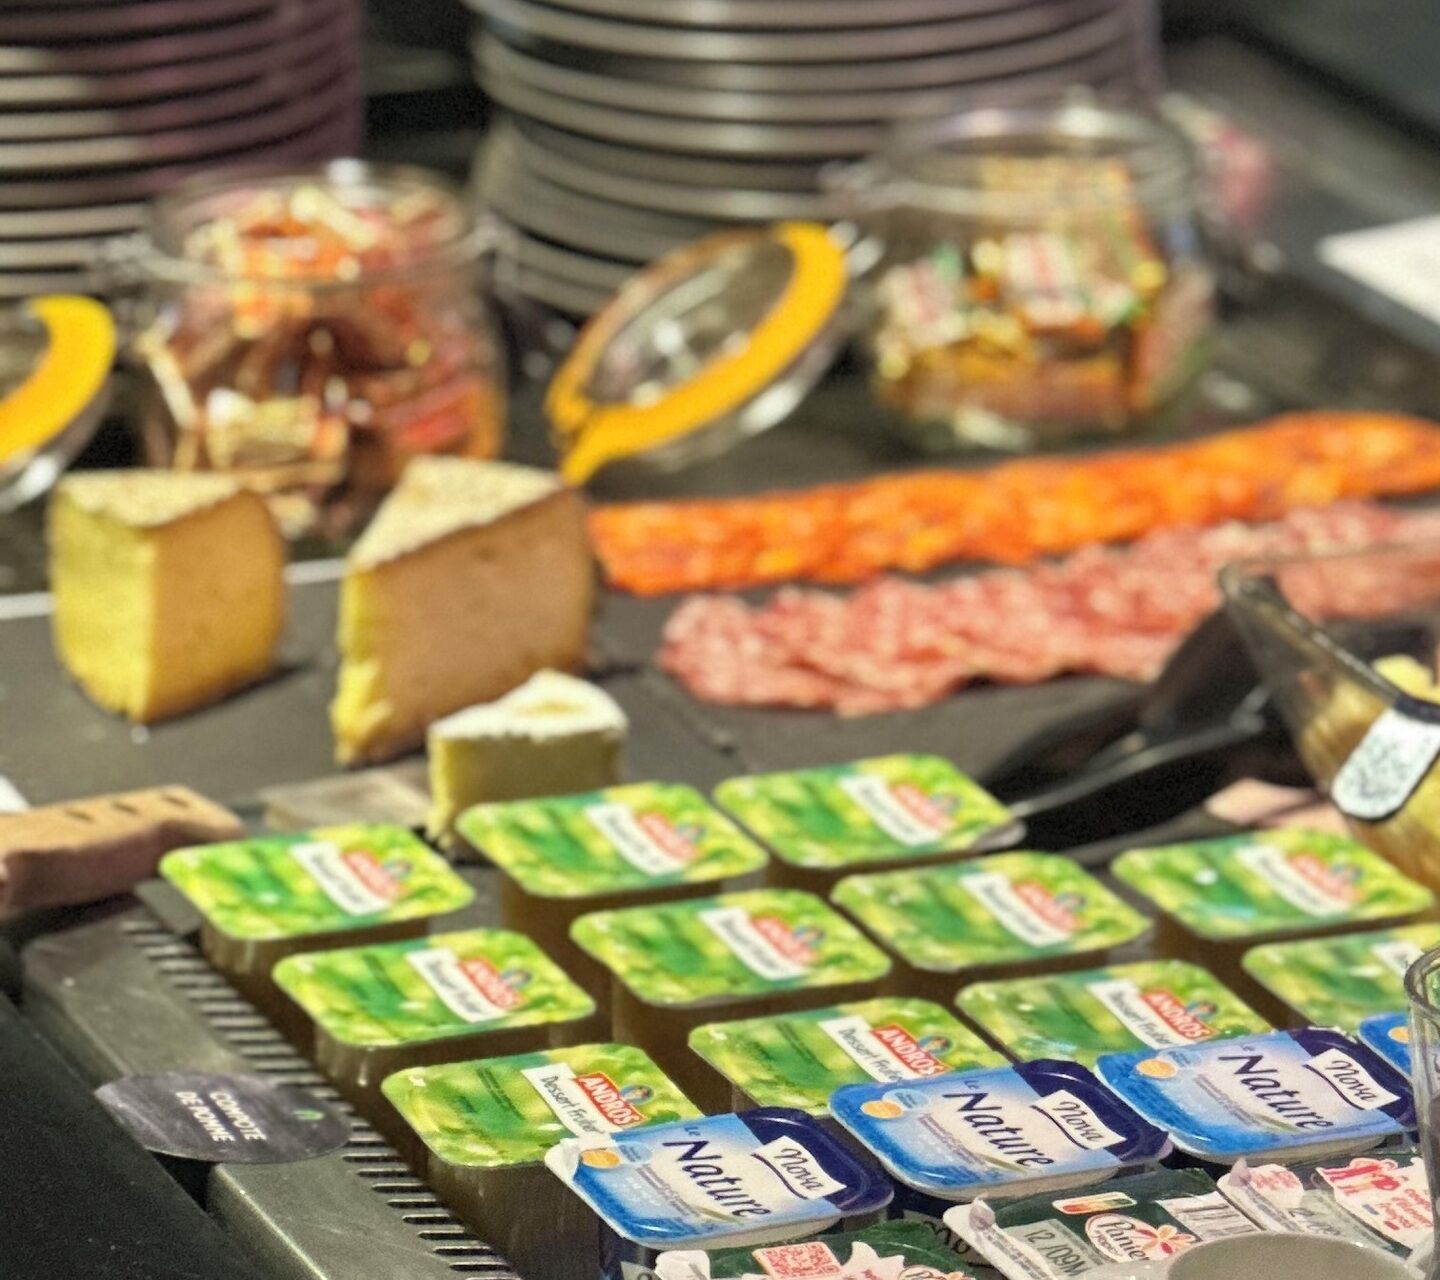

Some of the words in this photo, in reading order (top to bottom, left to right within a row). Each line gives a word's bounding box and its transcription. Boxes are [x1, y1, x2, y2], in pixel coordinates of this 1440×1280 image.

[1147, 991, 1211, 1038] ANDROS
[874, 1028, 946, 1076] ANDROS
[175, 1091, 204, 1106] DE
[540, 1075, 581, 1108] Dessert
[578, 1076, 640, 1126] ANDROS
[1217, 1053, 1334, 1129] Nature
[1326, 1059, 1378, 1102] Nova
[188, 1106, 236, 1142] POMME
[209, 1090, 268, 1141] COMPOTE
[942, 1091, 1055, 1167] Nature
[1050, 1100, 1104, 1143] Nova
[661, 1139, 772, 1219] Nature
[773, 1147, 825, 1192] Nova
[1023, 1227, 1055, 1244] 12
